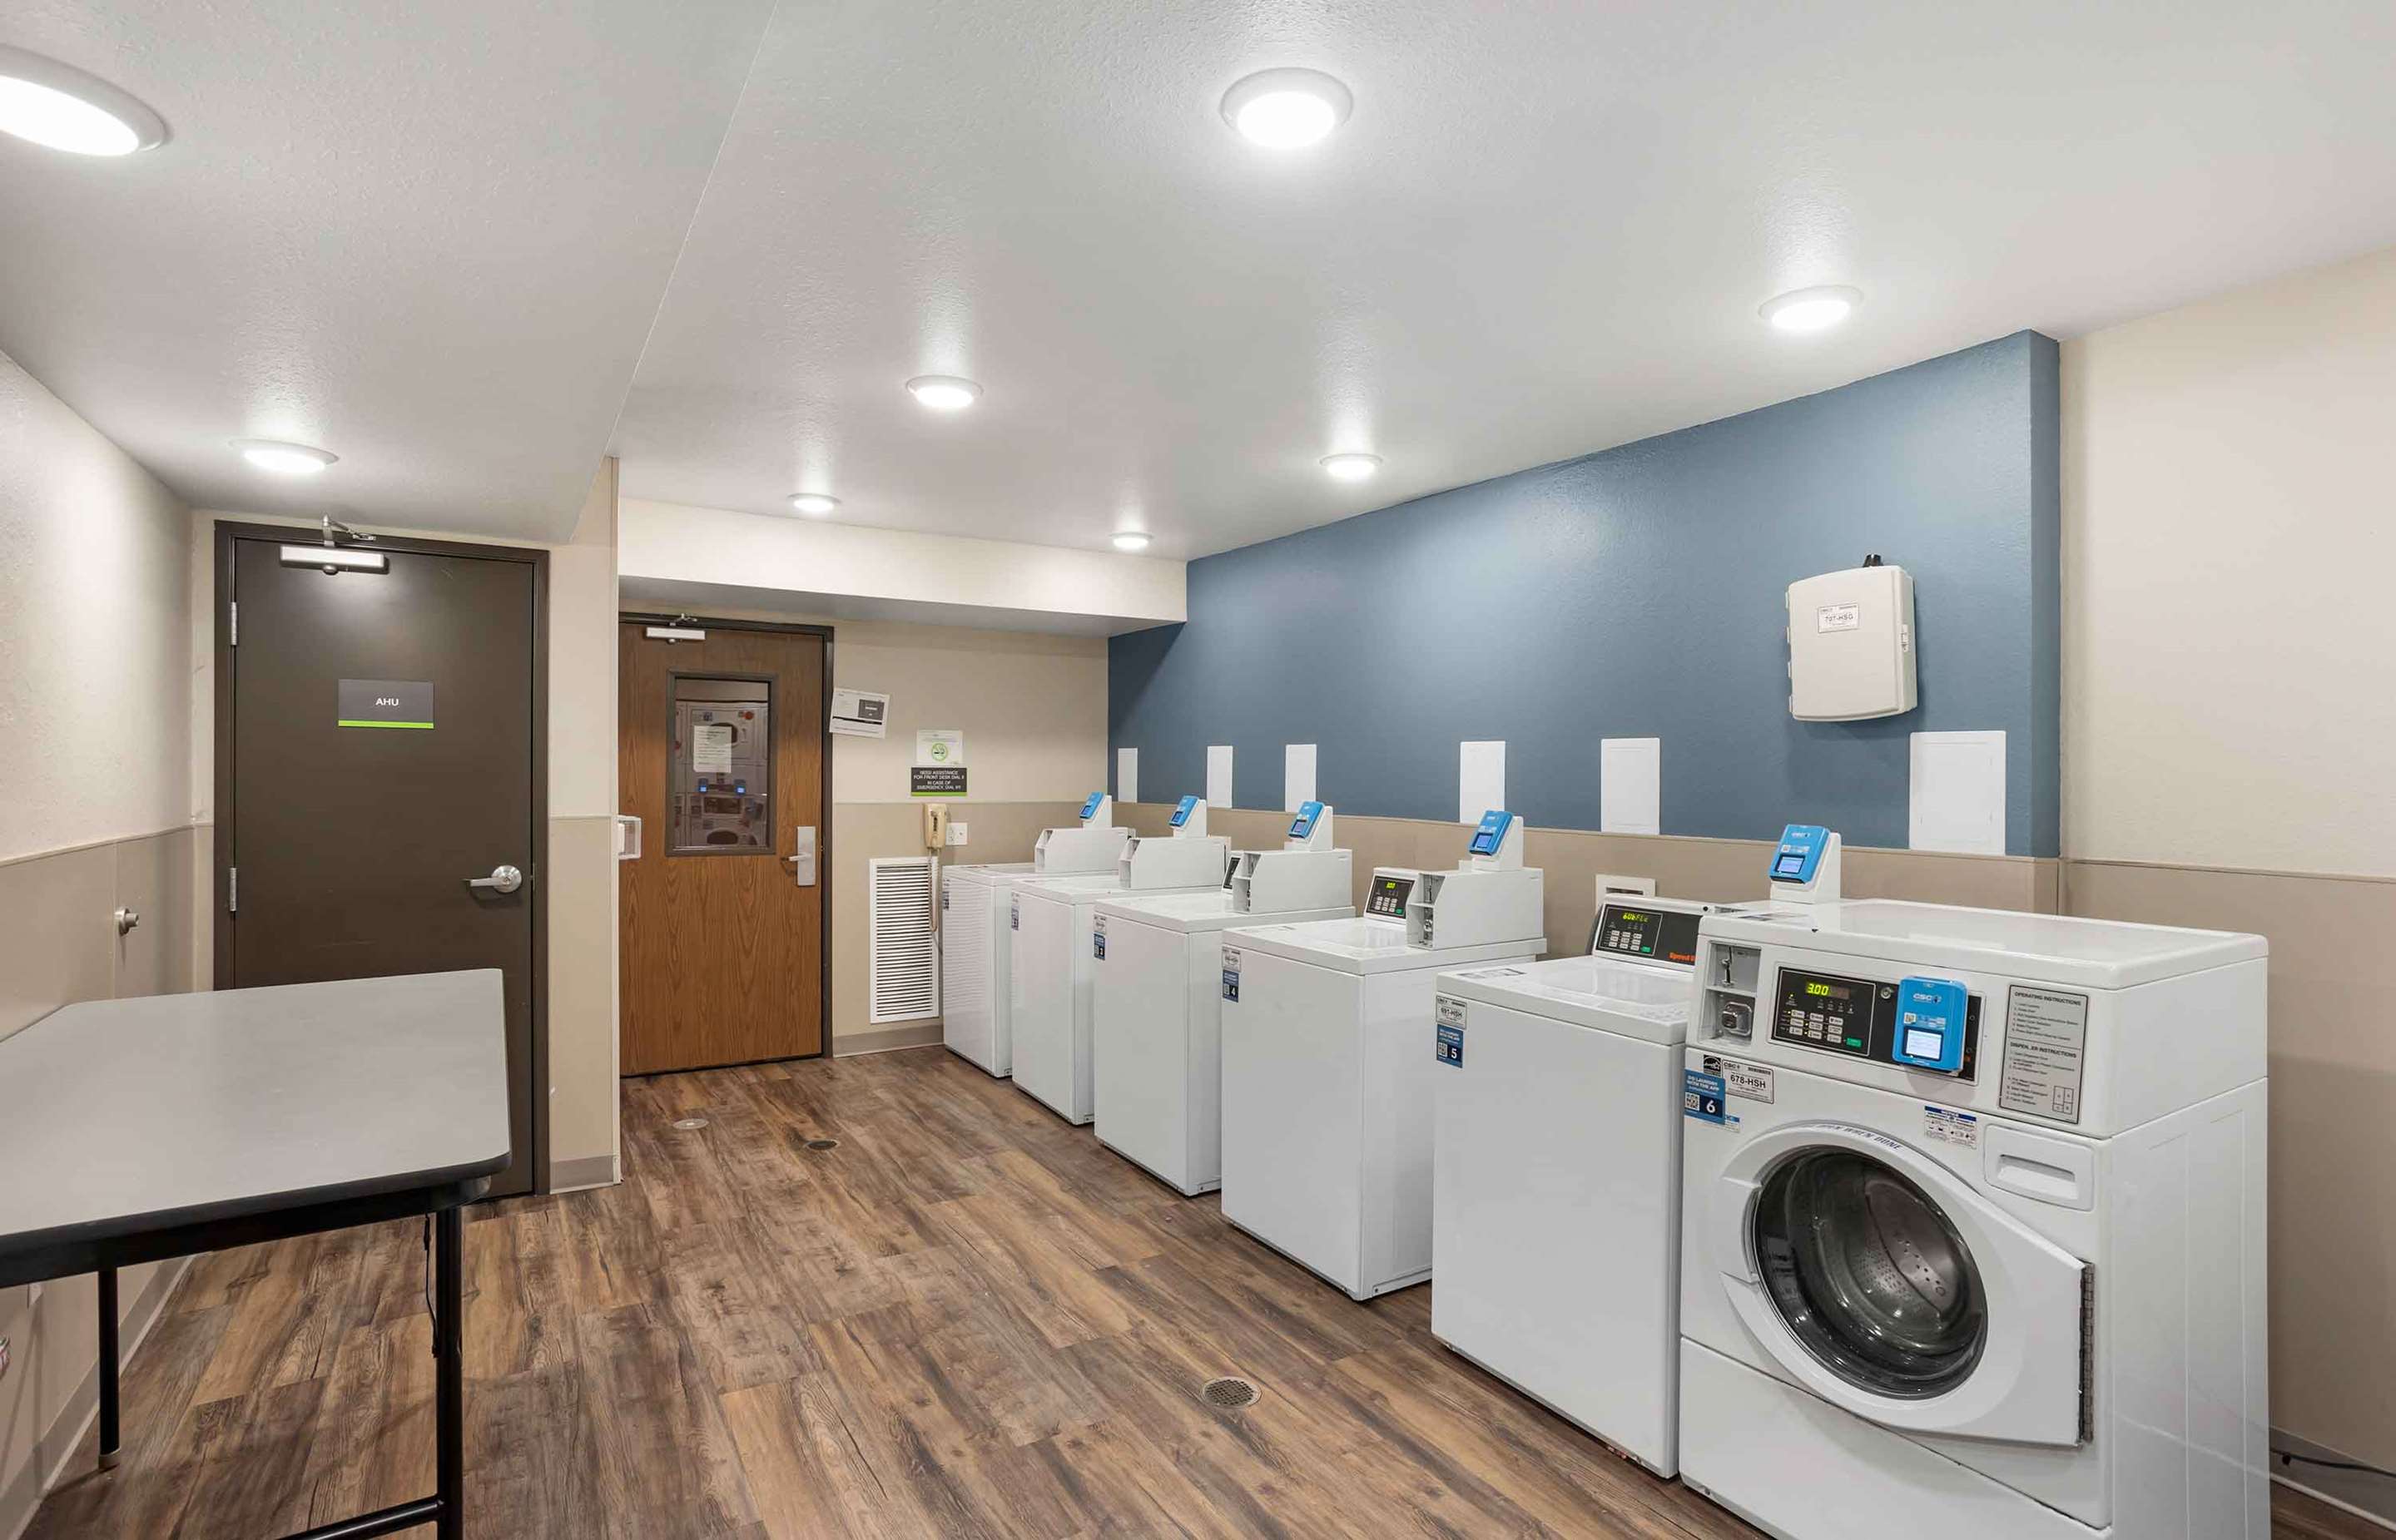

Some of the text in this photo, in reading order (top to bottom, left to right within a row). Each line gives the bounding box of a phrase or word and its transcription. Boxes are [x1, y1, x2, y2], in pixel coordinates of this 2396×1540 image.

[375, 697, 399, 706] AHU
[1807, 983, 1829, 996] 3.00
[2014, 991, 2043, 1001] OPERATING
[2043, 996, 2081, 1006] INSTRUCTIONS
[1451, 1047, 1457, 1059] 5
[2039, 1047, 2076, 1058] INSTRUCTIONS
[1730, 1074, 1766, 1088] 678-HSH
[1706, 1100, 1715, 1113] 6
